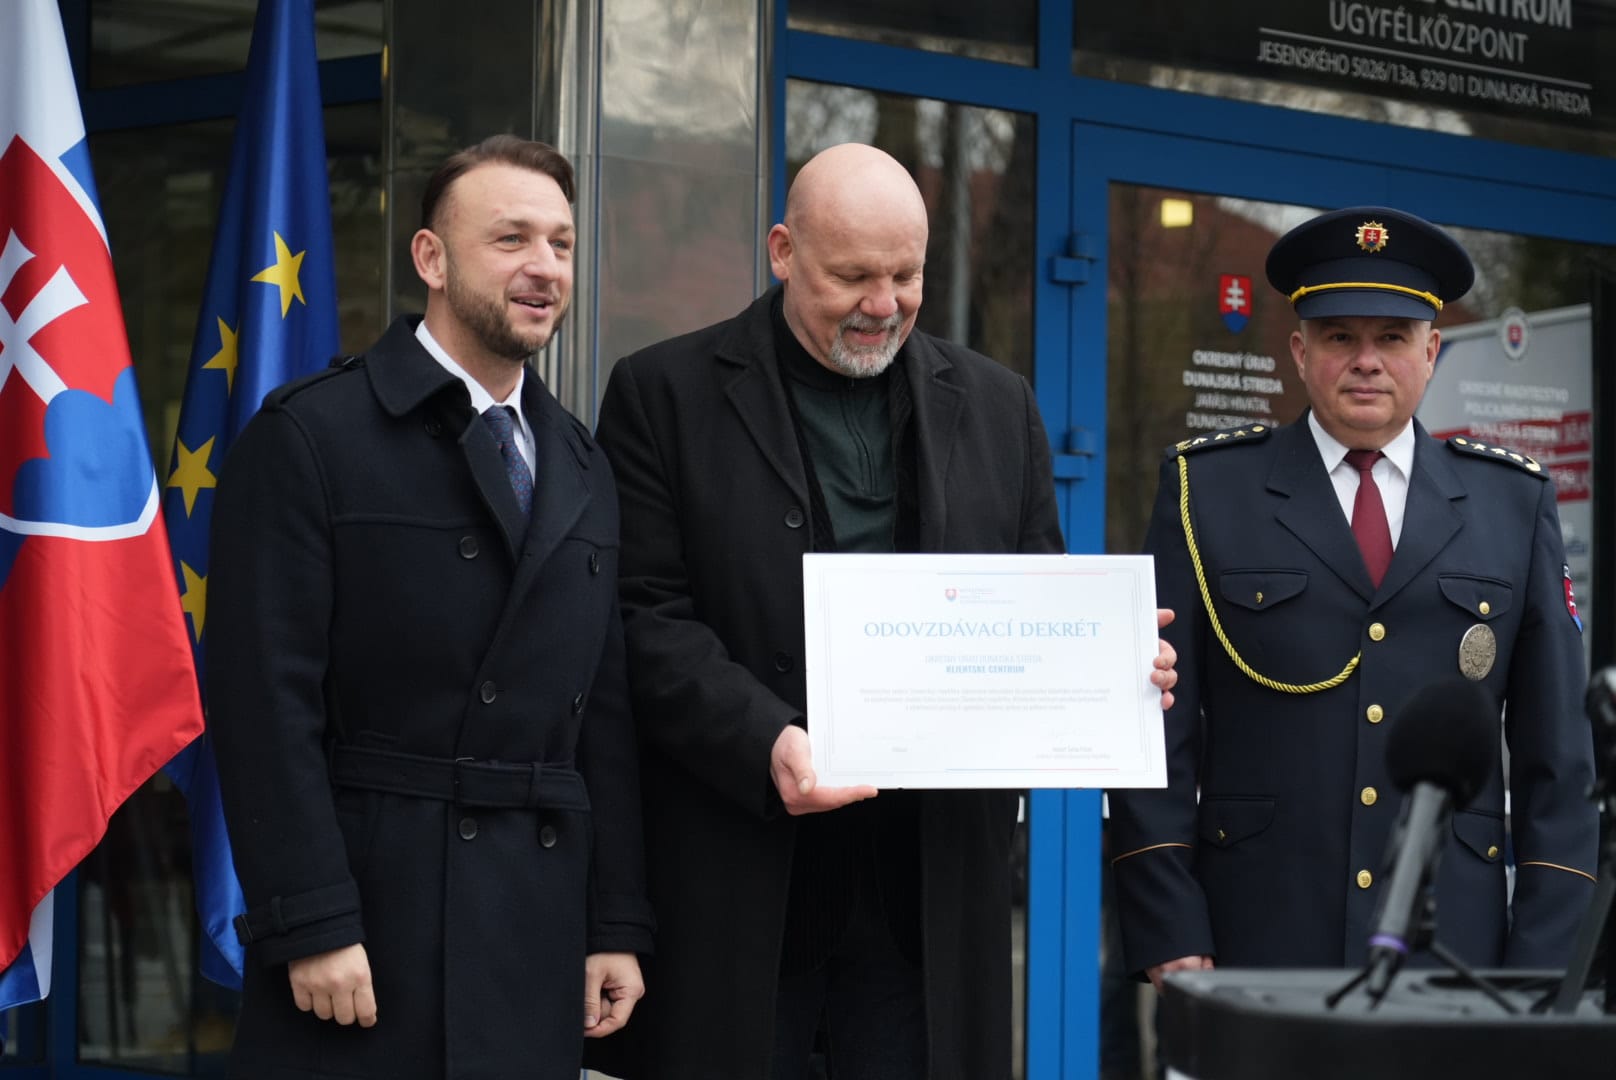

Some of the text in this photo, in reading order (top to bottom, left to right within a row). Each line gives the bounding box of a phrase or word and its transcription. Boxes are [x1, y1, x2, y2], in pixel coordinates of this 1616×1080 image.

[1257, 40, 1350, 75] JESENSKÉHO
[1420, 68, 1447, 92] 929
[1450, 72, 1465, 95] 01
[1468, 75, 1539, 106] DUNAJSKÁ
[1541, 87, 1592, 116] STREDA
[1242, 375, 1284, 394] STREDA
[864, 618, 1102, 638] ODOVZDÁVACÍ DEKRÉT
